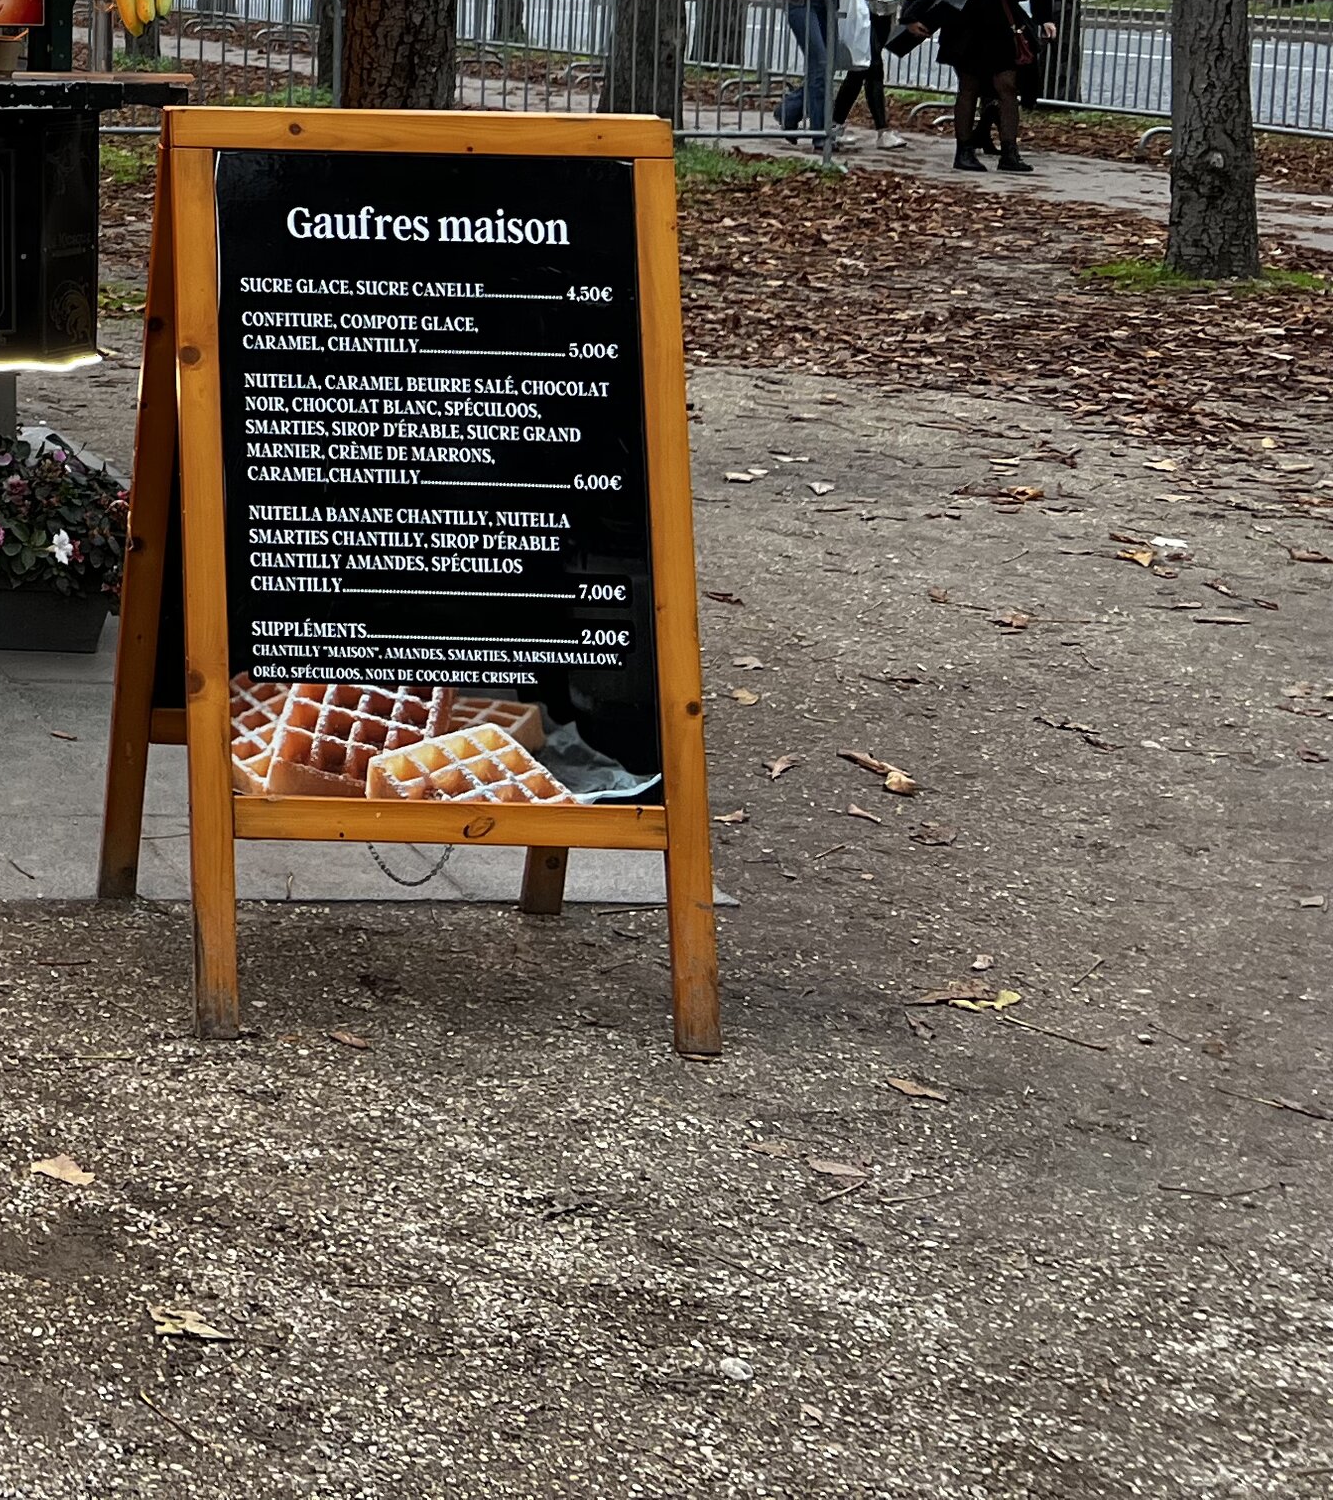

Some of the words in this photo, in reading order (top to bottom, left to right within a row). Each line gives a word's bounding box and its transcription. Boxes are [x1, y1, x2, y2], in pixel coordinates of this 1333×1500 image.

[287, 205, 429, 243] Gaufres
[438, 209, 570, 245] maison
[240, 278, 293, 294] SUCRE
[296, 279, 354, 296] GLACE,
[356, 280, 408, 296] SUCRE
[412, 282, 485, 298] CANELLE
[566, 286, 613, 303] 4,50€
[242, 312, 337, 330] CONFITURE,
[340, 314, 417, 330] COMPOTE
[421, 316, 479, 334] GLACE,
[242, 335, 324, 354] CARAMEL,
[328, 338, 419, 354] CHANTILLY
[569, 343, 619, 360] 5,00€
[244, 373, 322, 391] NUTELLA,
[324, 375, 403, 392] CARAMEL
[406, 377, 471, 393] BEURRE
[474, 375, 518, 396] SALÉ,
[521, 380, 609, 397] CHOCOLAT
[245, 396, 289, 414] NOIR,
[292, 398, 379, 415] CHOCOLAT
[383, 400, 441, 418] BLANC,
[444, 399, 542, 420] SPÉCULOOS,
[245, 420, 329, 438] SMARTIES,
[331, 422, 380, 438] SIROP
[383, 421, 464, 441] D'ÉRABLE,
[467, 425, 520, 441] SUCRE
[523, 427, 581, 443] GRAND
[247, 443, 326, 461] MARNIER,
[328, 441, 383, 461] CRÈME
[387, 446, 408, 462] DE
[411, 447, 495, 466] MARRONS,
[574, 474, 622, 491] 6,00€
[249, 505, 322, 522] NUTELLA
[326, 507, 393, 523] BANANE
[396, 509, 493, 527] CHANTILLY,
[496, 512, 570, 529] NUTELLA
[249, 529, 329, 546] SMARTIES
[332, 531, 428, 549] CHANTILLY,
[431, 534, 480, 549] SIROP
[483, 532, 560, 552] D'ÉRABLE
[250, 552, 341, 569] CHANTILLY
[345, 554, 428, 573] AMANDES,
[431, 554, 523, 574] SPÉCULLOS
[251, 576, 342, 593] CHANTILLY
[578, 583, 626, 602] 7,00€
[252, 618, 367, 639] SUPPLÉMENTS
[253, 644, 321, 658] CHANTILLY
[365, 668, 395, 682] NOIX
[398, 670, 414, 682] DE
